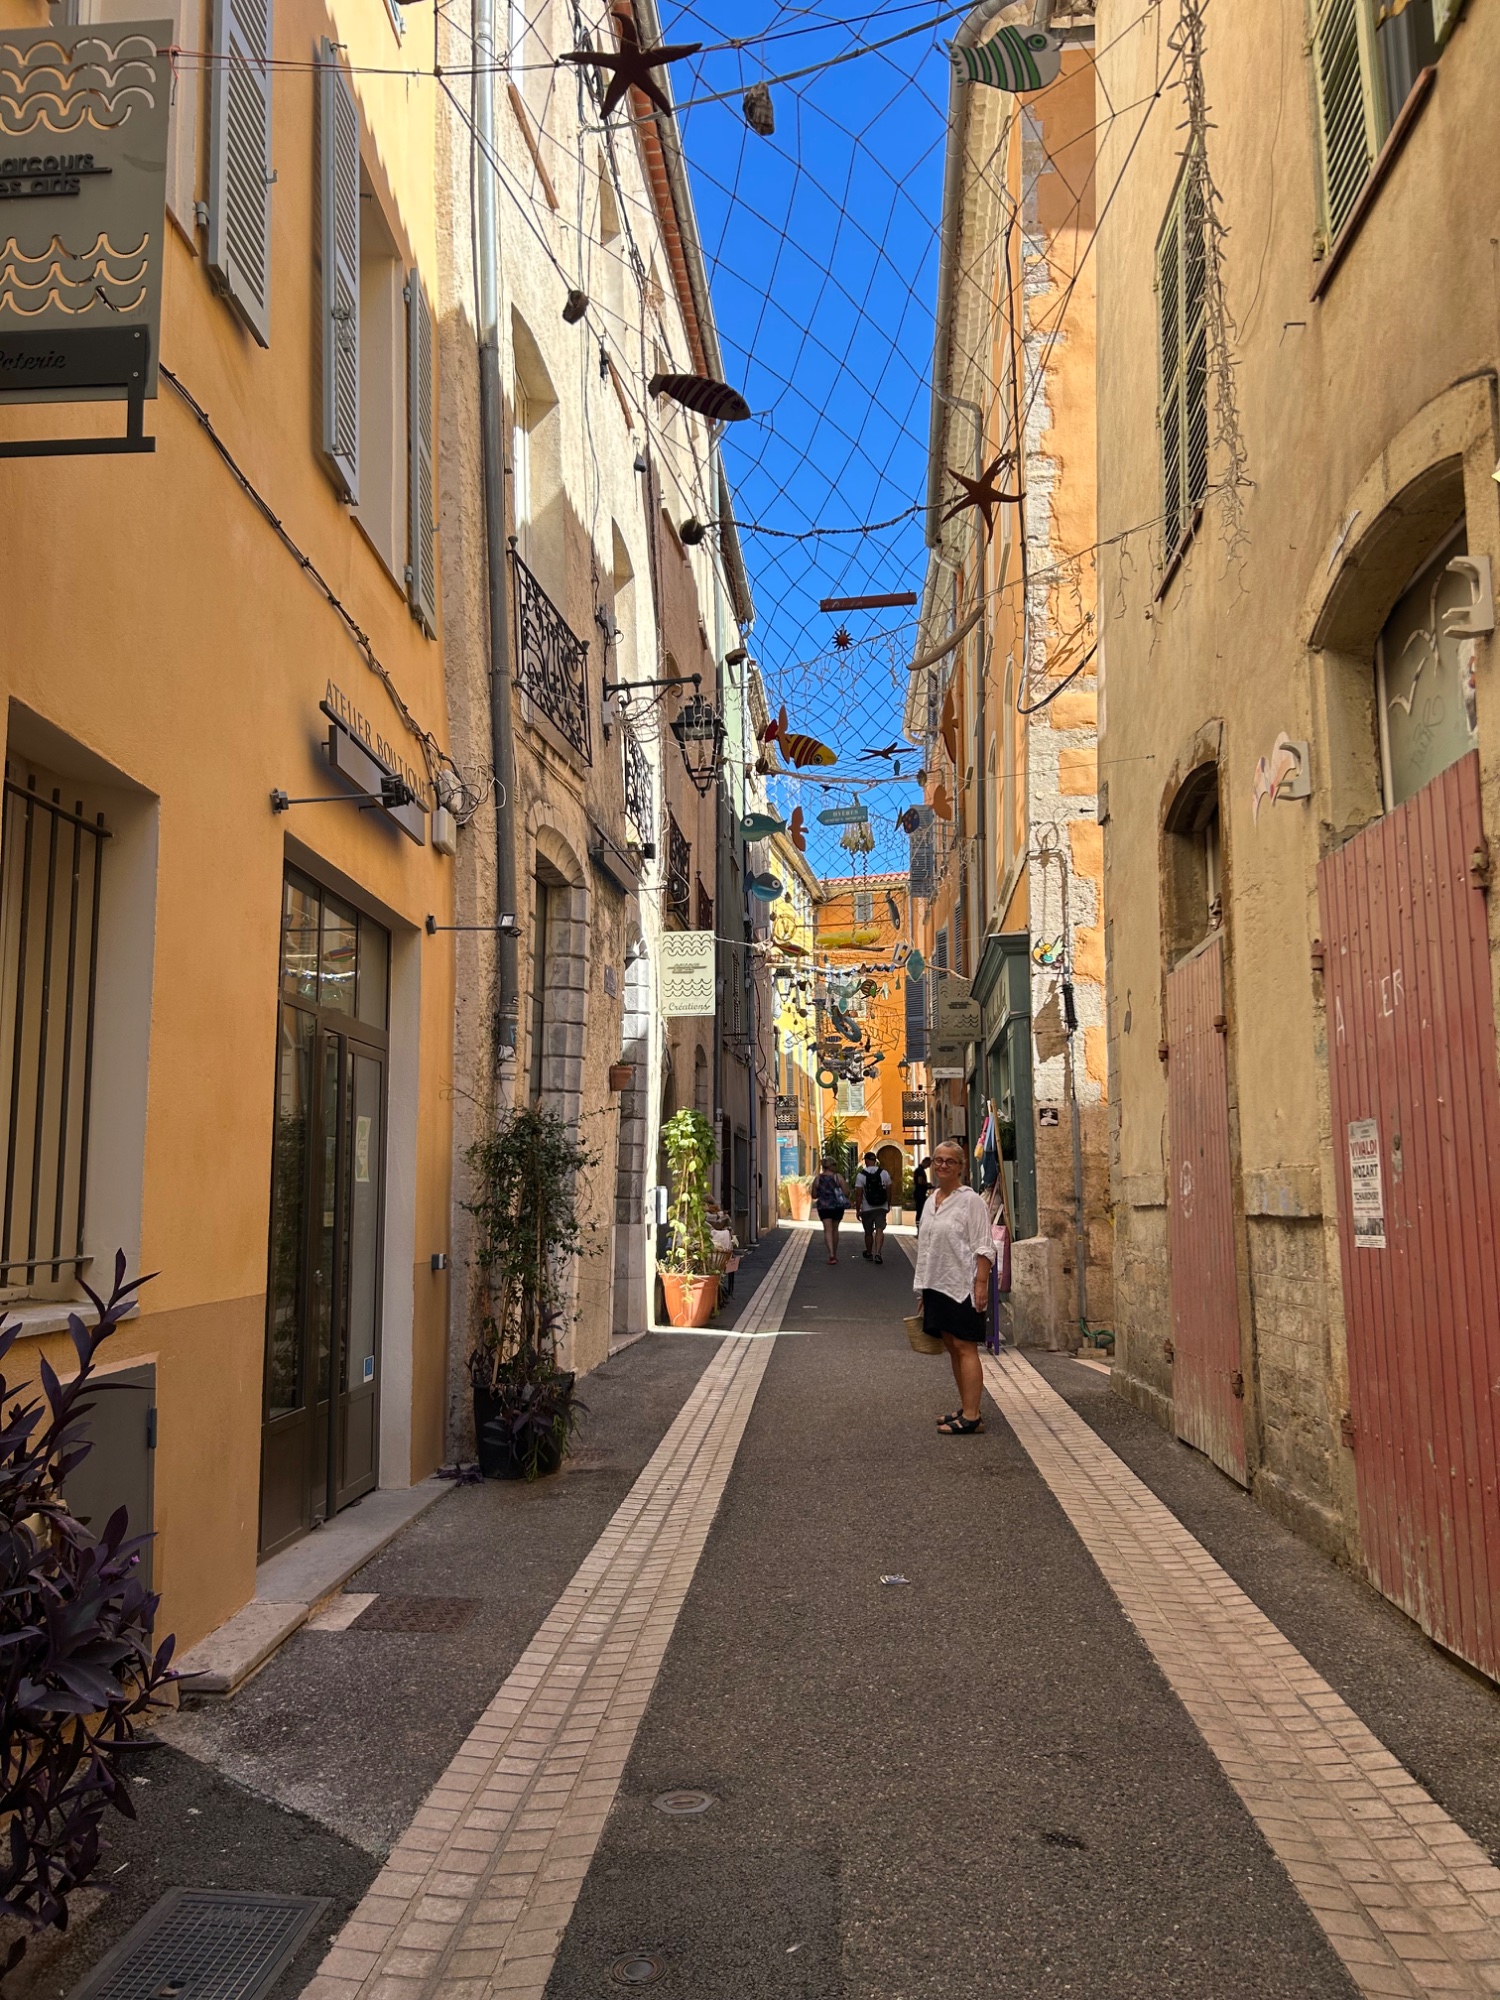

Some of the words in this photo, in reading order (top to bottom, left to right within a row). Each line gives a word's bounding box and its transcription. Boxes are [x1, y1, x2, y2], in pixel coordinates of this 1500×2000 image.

[0, 153, 94, 174] arcours
[31, 176, 80, 195] arts
[325, 678, 372, 748] ATELIER
[1350, 1139, 1378, 1157] VIVALDI
[1352, 1164, 1378, 1178] MOZART
